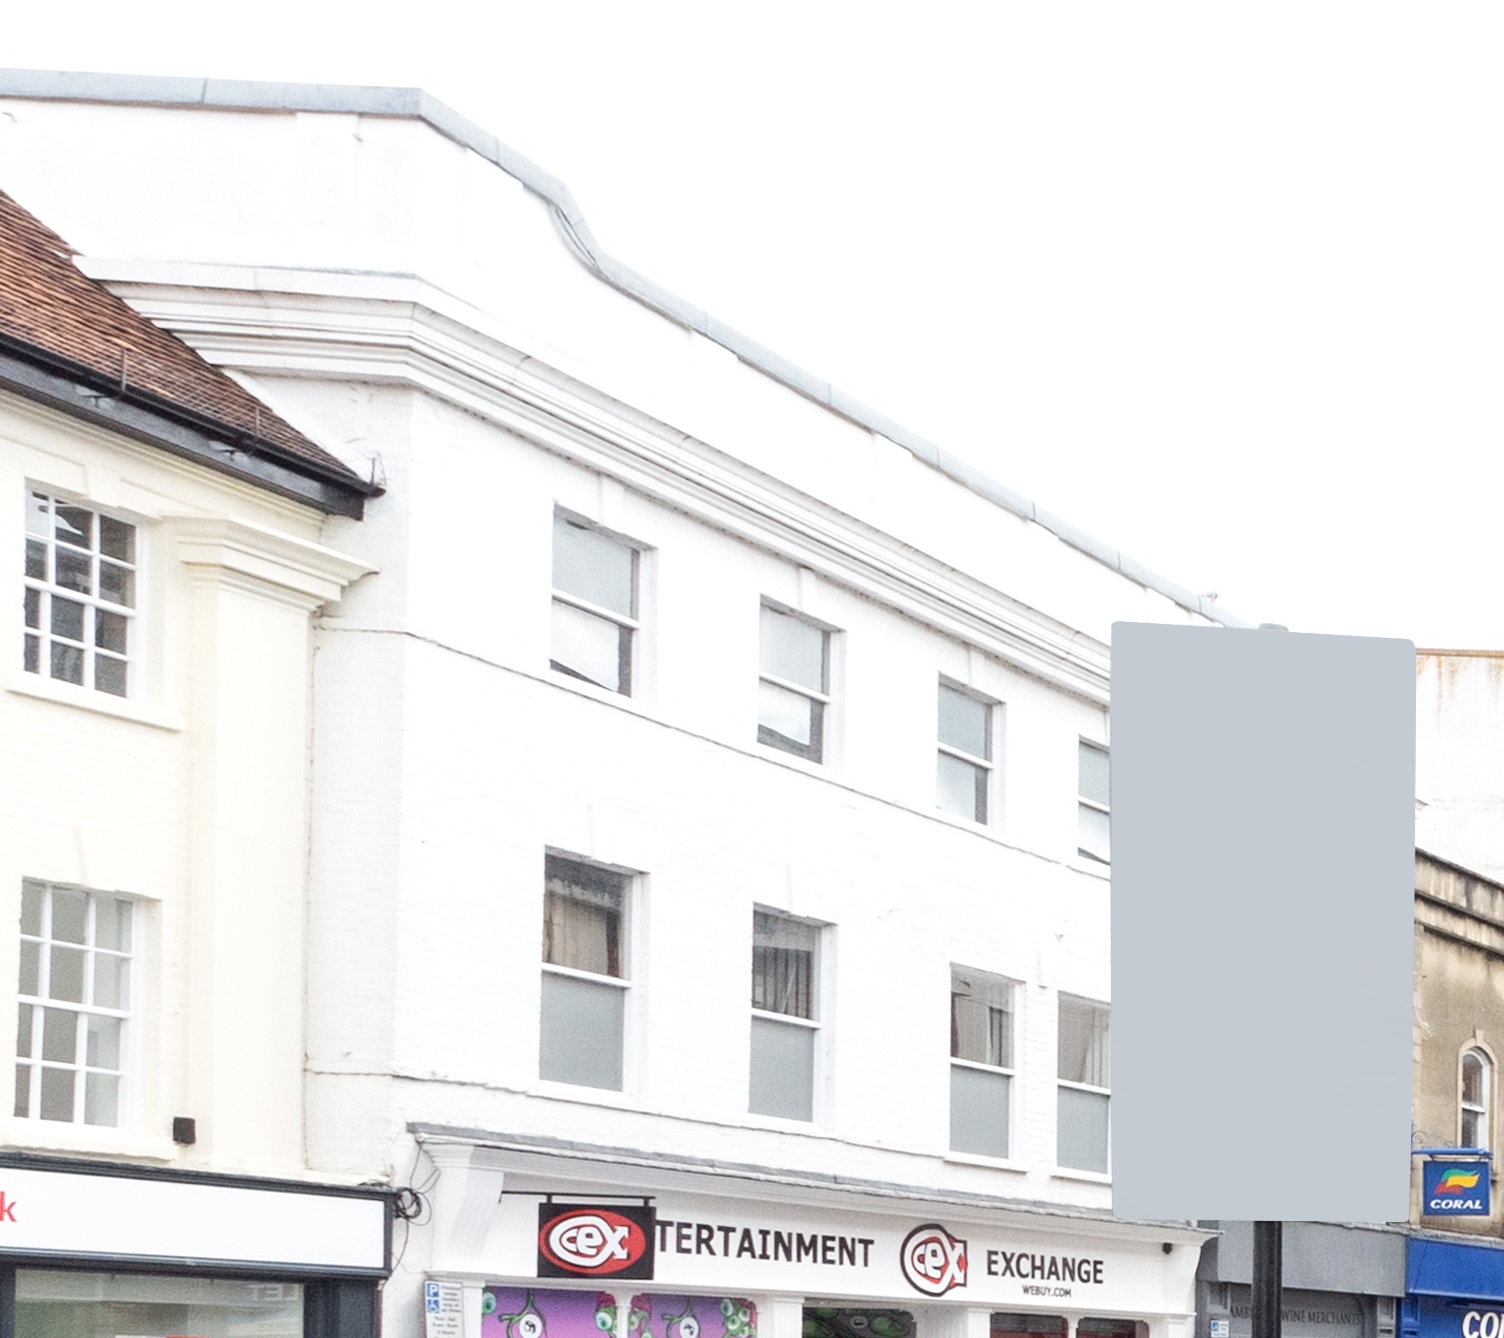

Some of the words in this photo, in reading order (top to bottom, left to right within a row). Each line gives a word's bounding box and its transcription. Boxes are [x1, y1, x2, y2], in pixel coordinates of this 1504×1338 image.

[1430, 1198, 1483, 1211] CORAL
[986, 1249, 1105, 1284] EXCHANGE
[1022, 1285, 1073, 1299] WEBUY.COM
[1307, 1310, 1362, 1326] MERCHANTS
